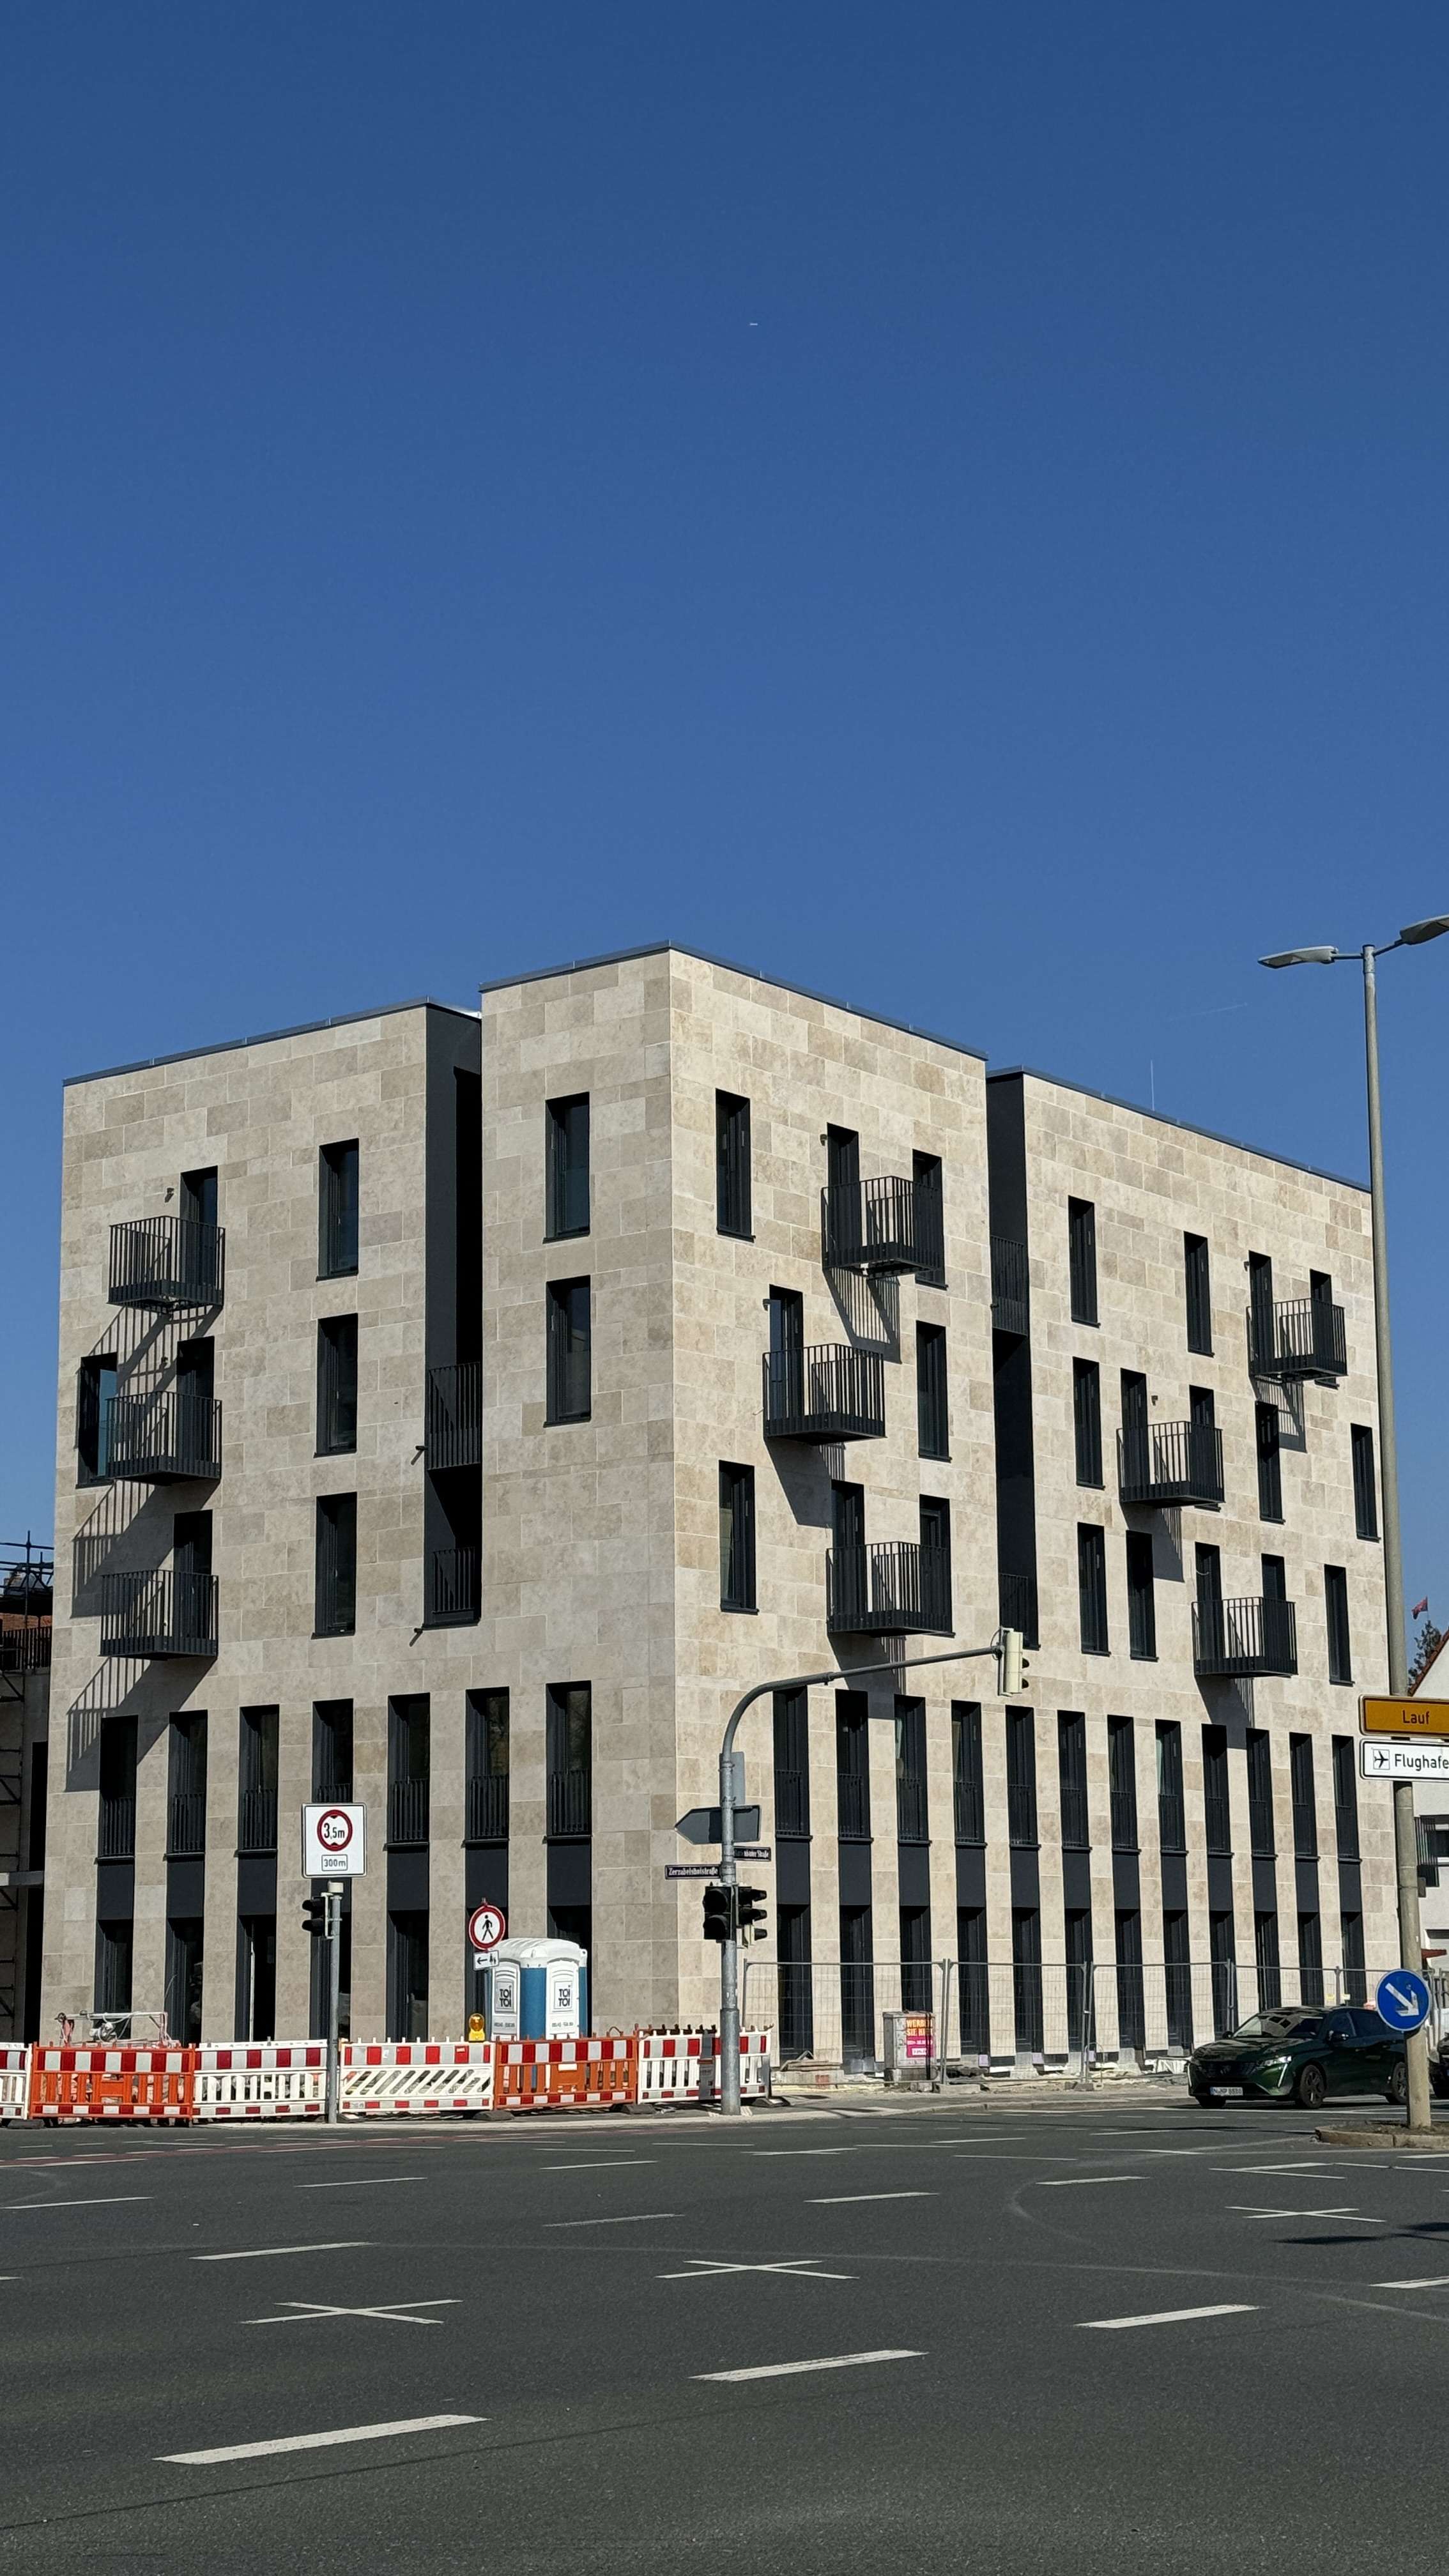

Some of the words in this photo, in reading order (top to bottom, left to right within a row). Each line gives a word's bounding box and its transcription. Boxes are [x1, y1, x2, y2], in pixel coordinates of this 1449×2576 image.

[1402, 1709, 1430, 1724] Lauf
[499, 1986, 512, 1998] TOI
[558, 1986, 571, 1998] TOI
[499, 1998, 512, 2007] TOI
[558, 1998, 571, 2007] TOI
[906, 2018, 933, 2028] WERB
